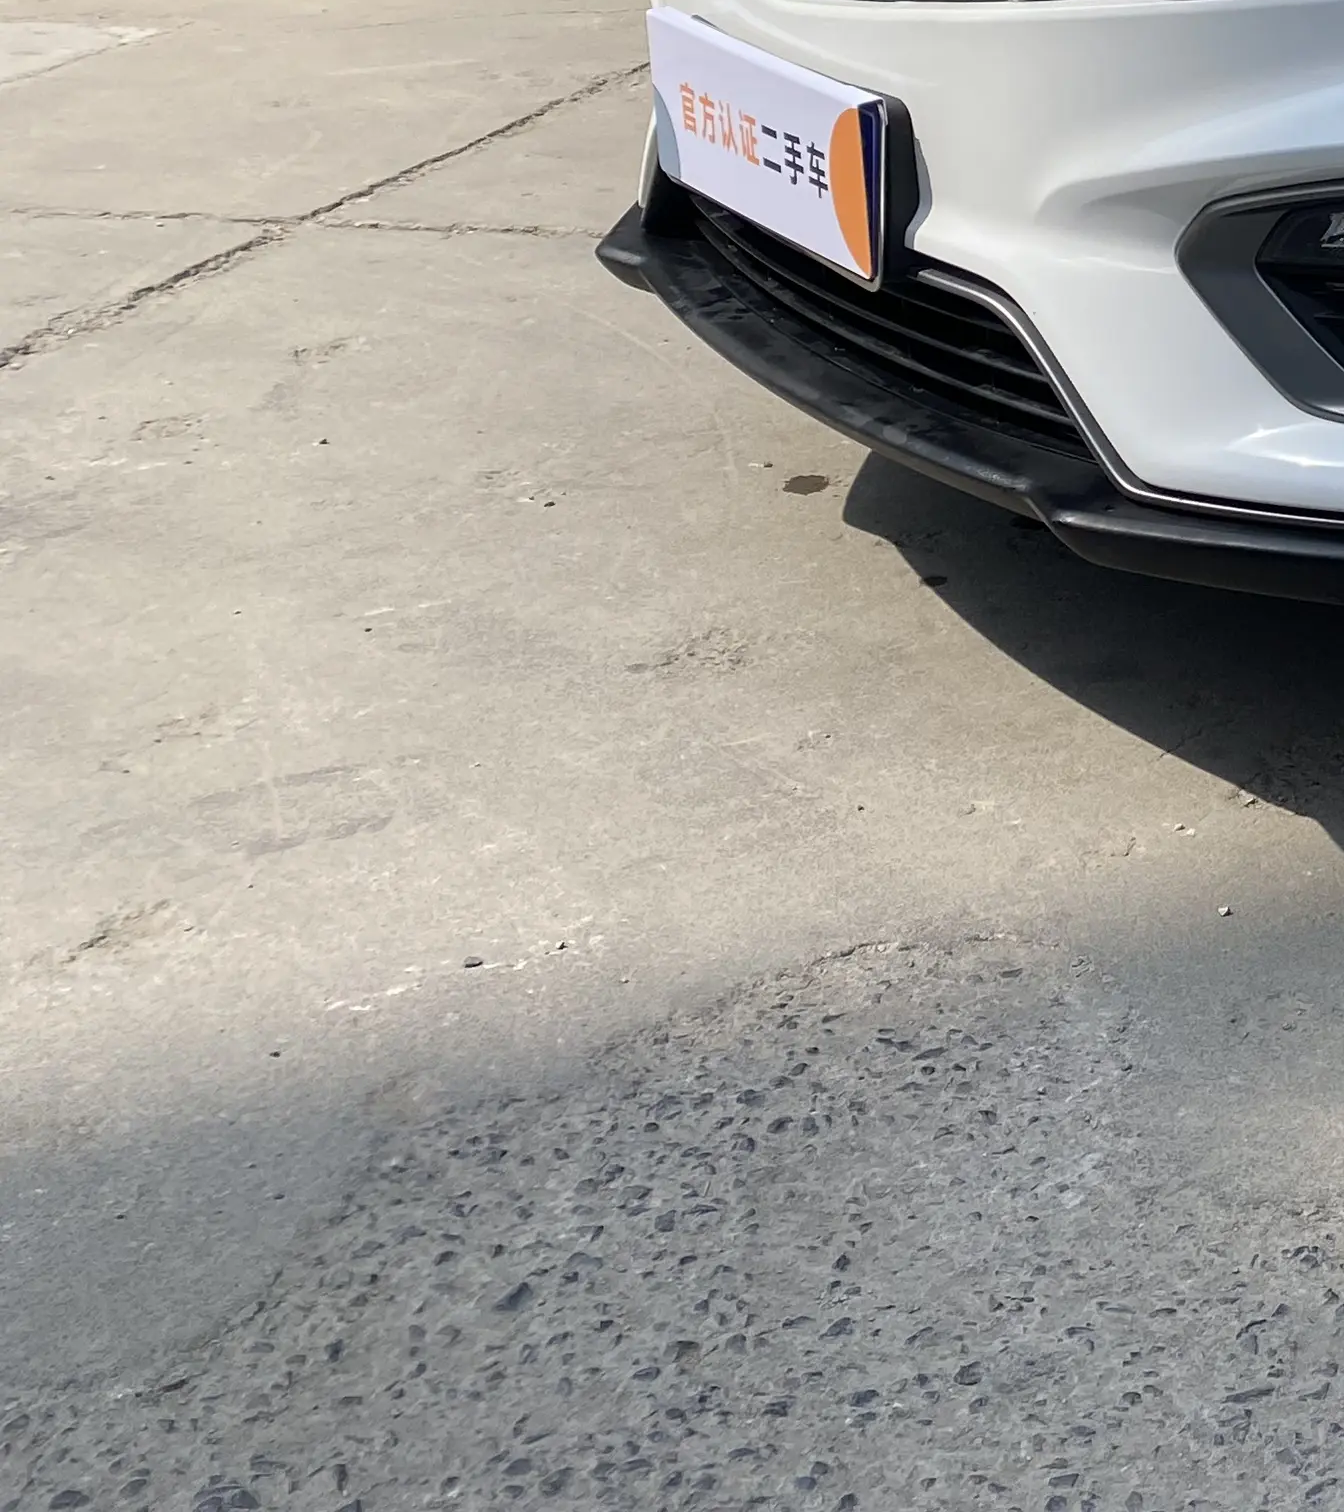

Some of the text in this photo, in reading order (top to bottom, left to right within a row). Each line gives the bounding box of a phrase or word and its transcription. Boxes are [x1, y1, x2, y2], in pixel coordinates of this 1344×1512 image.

[679, 81, 829, 200] 官方认证二手车
